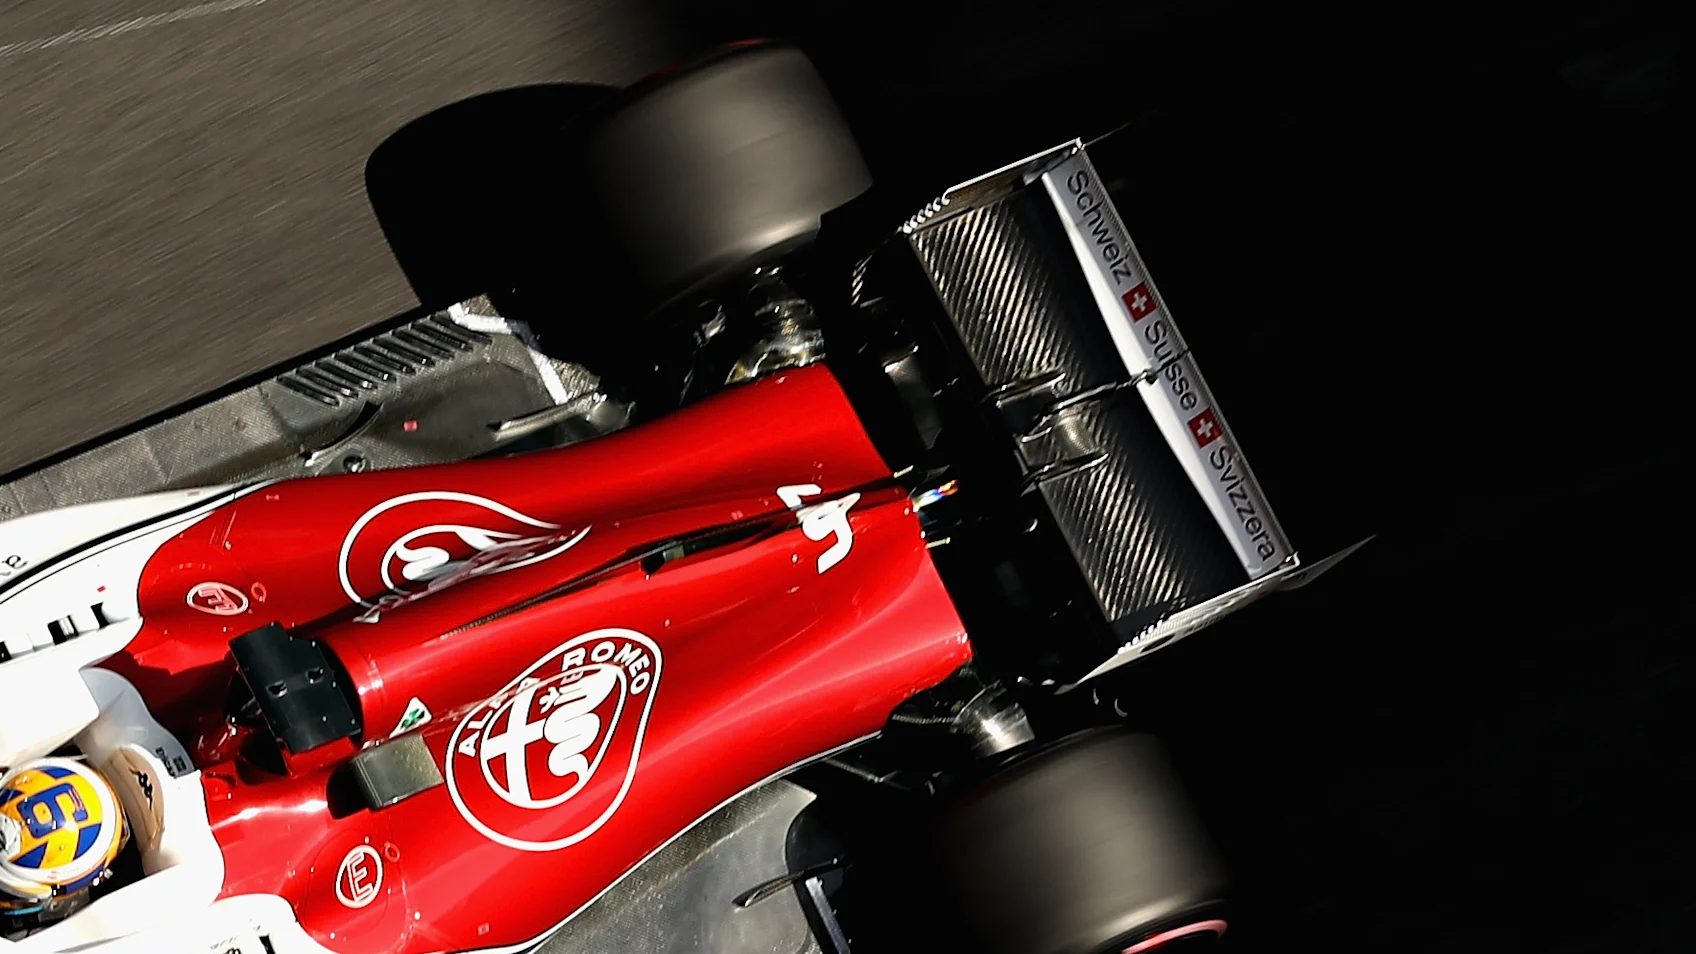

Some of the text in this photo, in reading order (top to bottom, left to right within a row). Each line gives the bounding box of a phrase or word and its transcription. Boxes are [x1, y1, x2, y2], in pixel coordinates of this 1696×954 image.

[1066, 170, 1276, 562] Schweiz Suisse Svizzera
[560, 640, 651, 696] ROMEO
[345, 850, 376, 904] E
